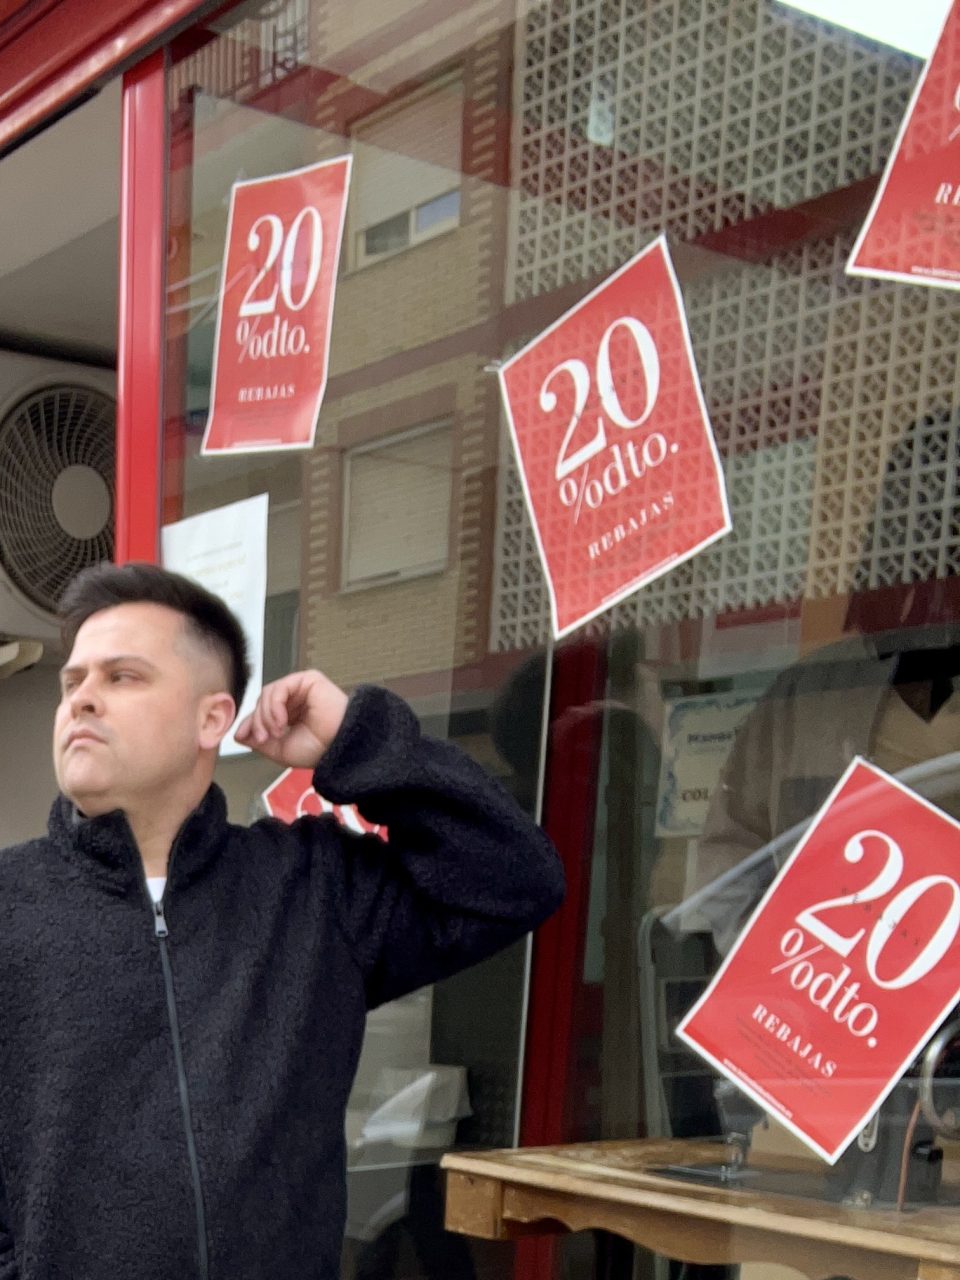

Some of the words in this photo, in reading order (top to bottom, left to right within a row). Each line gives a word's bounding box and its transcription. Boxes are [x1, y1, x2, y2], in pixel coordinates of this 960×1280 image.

[239, 205, 324, 314] 20
[235, 314, 311, 364] %dto.
[238, 383, 295, 402] REBAJAS
[538, 315, 662, 481] 20
[558, 431, 680, 526] %dto.
[587, 491, 675, 561] REBAJAS
[794, 829, 960, 991] 20
[770, 928, 880, 1048] %dto.
[752, 1004, 837, 1077] REBAJAS
